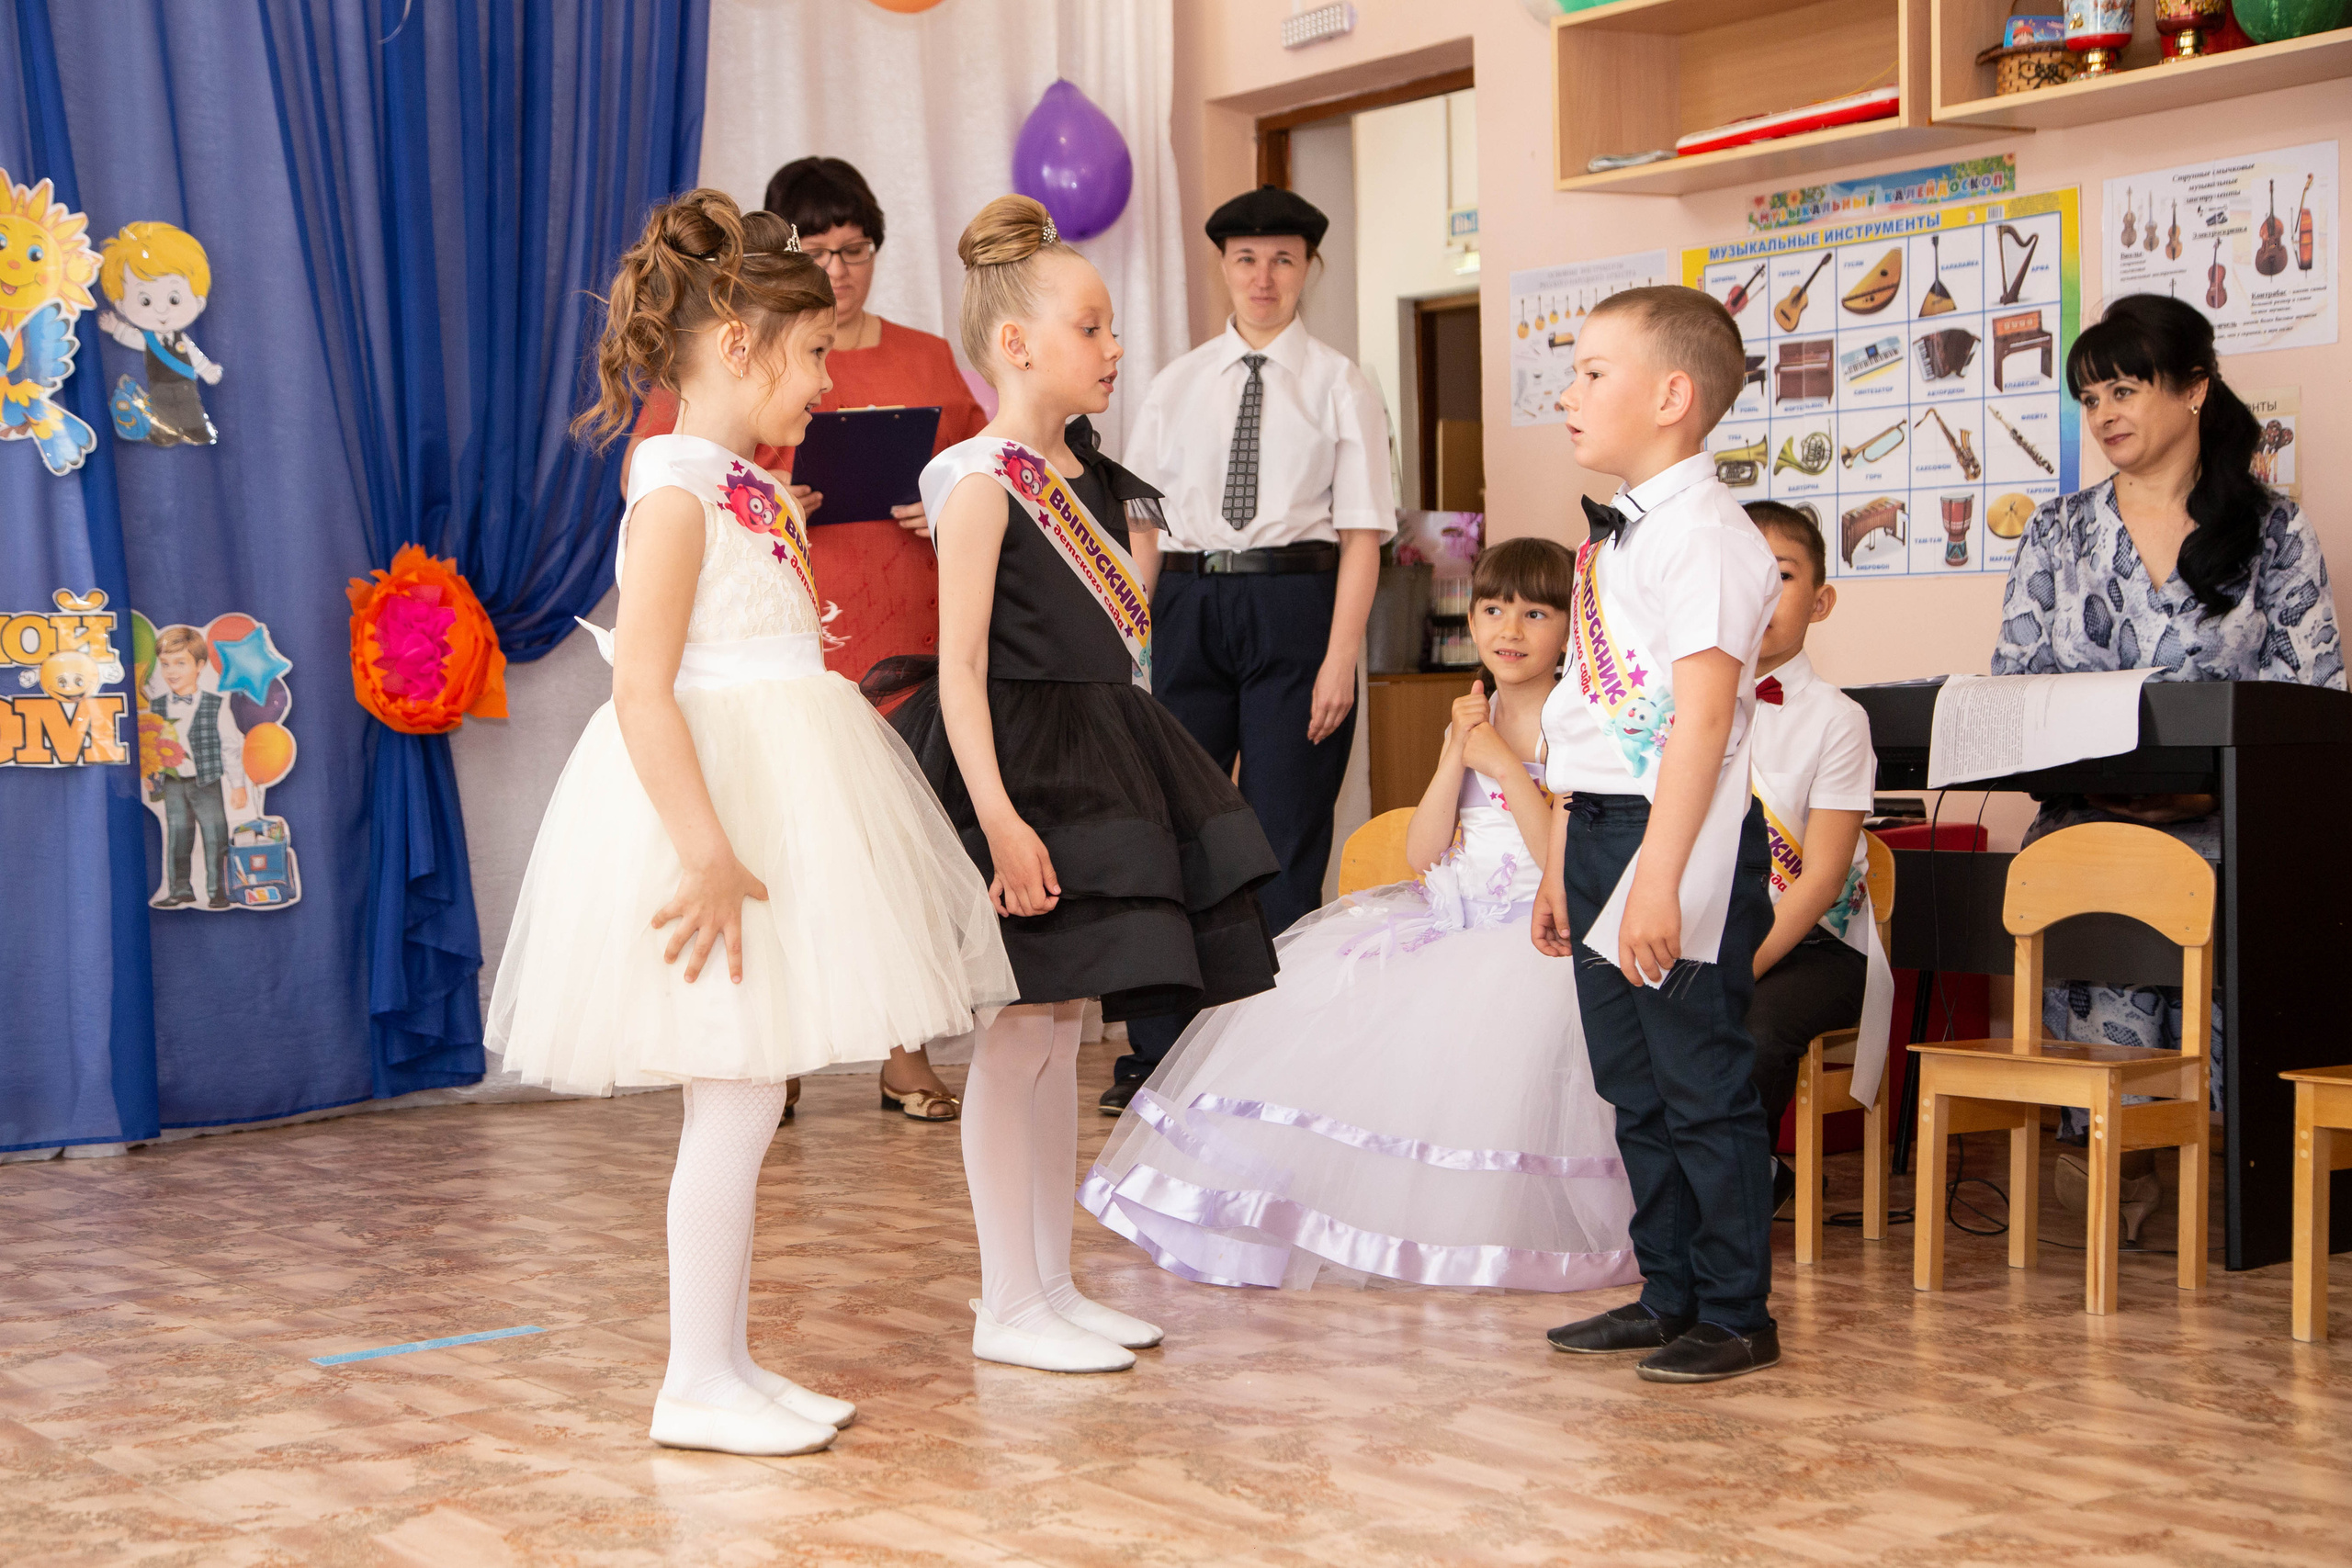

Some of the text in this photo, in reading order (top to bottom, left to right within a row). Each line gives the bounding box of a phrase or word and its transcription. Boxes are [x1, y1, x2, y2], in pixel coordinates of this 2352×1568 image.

[1884, 172, 2005, 203] КАЛЕЙДОСКОП
[1759, 189, 1876, 223] МУЗЫКАЛЬНЫЙ
[1710, 212, 1940, 260] МУЗЫКАЛЬНЫЕ ИНСТРУМЕНТЫ
[2031, 264, 2050, 272] АРФА
[2004, 380, 2040, 389] КЛАВЕСИН
[2250, 400, 2278, 412] НТЫ
[1916, 464, 1951, 472] САКСОФОН
[1048, 487, 1150, 637] ВЫПУСКНИК
[1053, 524, 1125, 631] детского сада
[0, 590, 116, 666] ОЙ
[1580, 662, 1591, 695] сада
[1770, 872, 1788, 893] да
